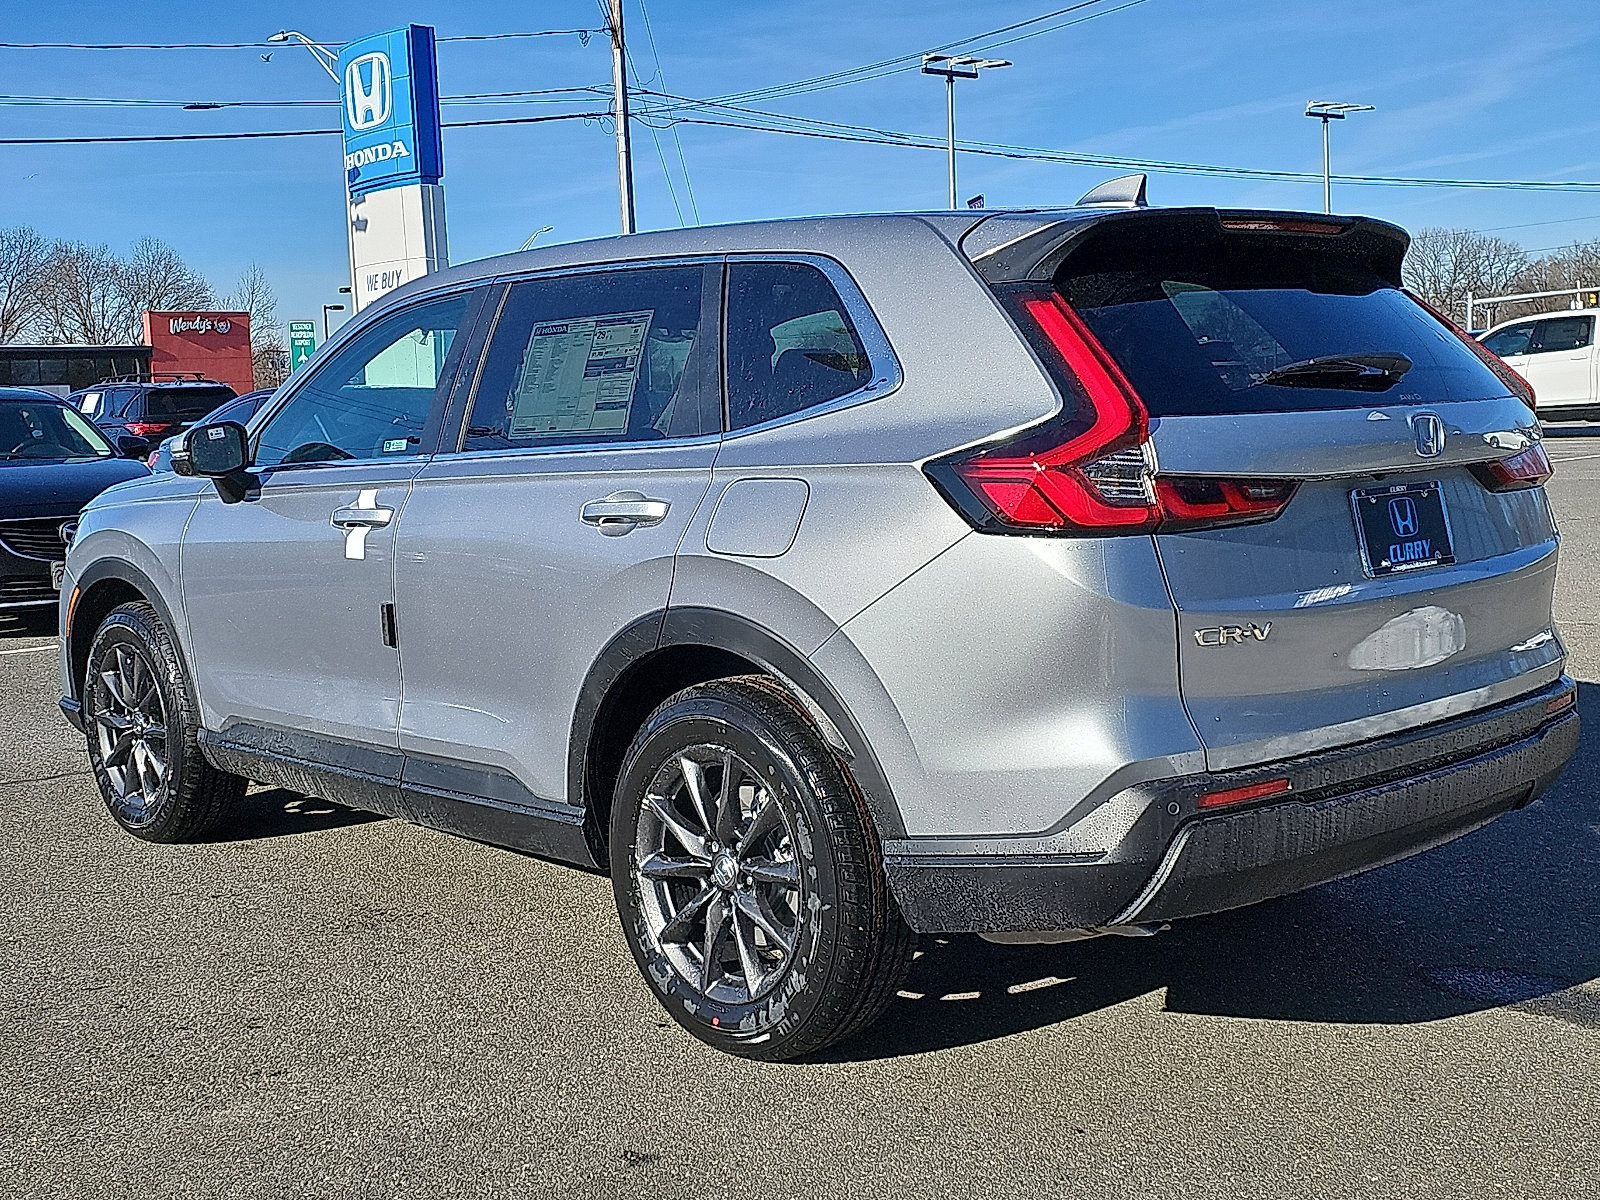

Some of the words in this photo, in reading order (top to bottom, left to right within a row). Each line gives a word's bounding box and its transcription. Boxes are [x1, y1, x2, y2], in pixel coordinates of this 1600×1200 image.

[345, 141, 409, 170] HONDA
[366, 273, 379, 292] WE
[381, 269, 402, 289] BUY
[169, 316, 212, 334] Wendy's
[542, 326, 567, 335] HONDA
[1390, 539, 1430, 563] CURRY
[1194, 621, 1272, 646] CR-V
